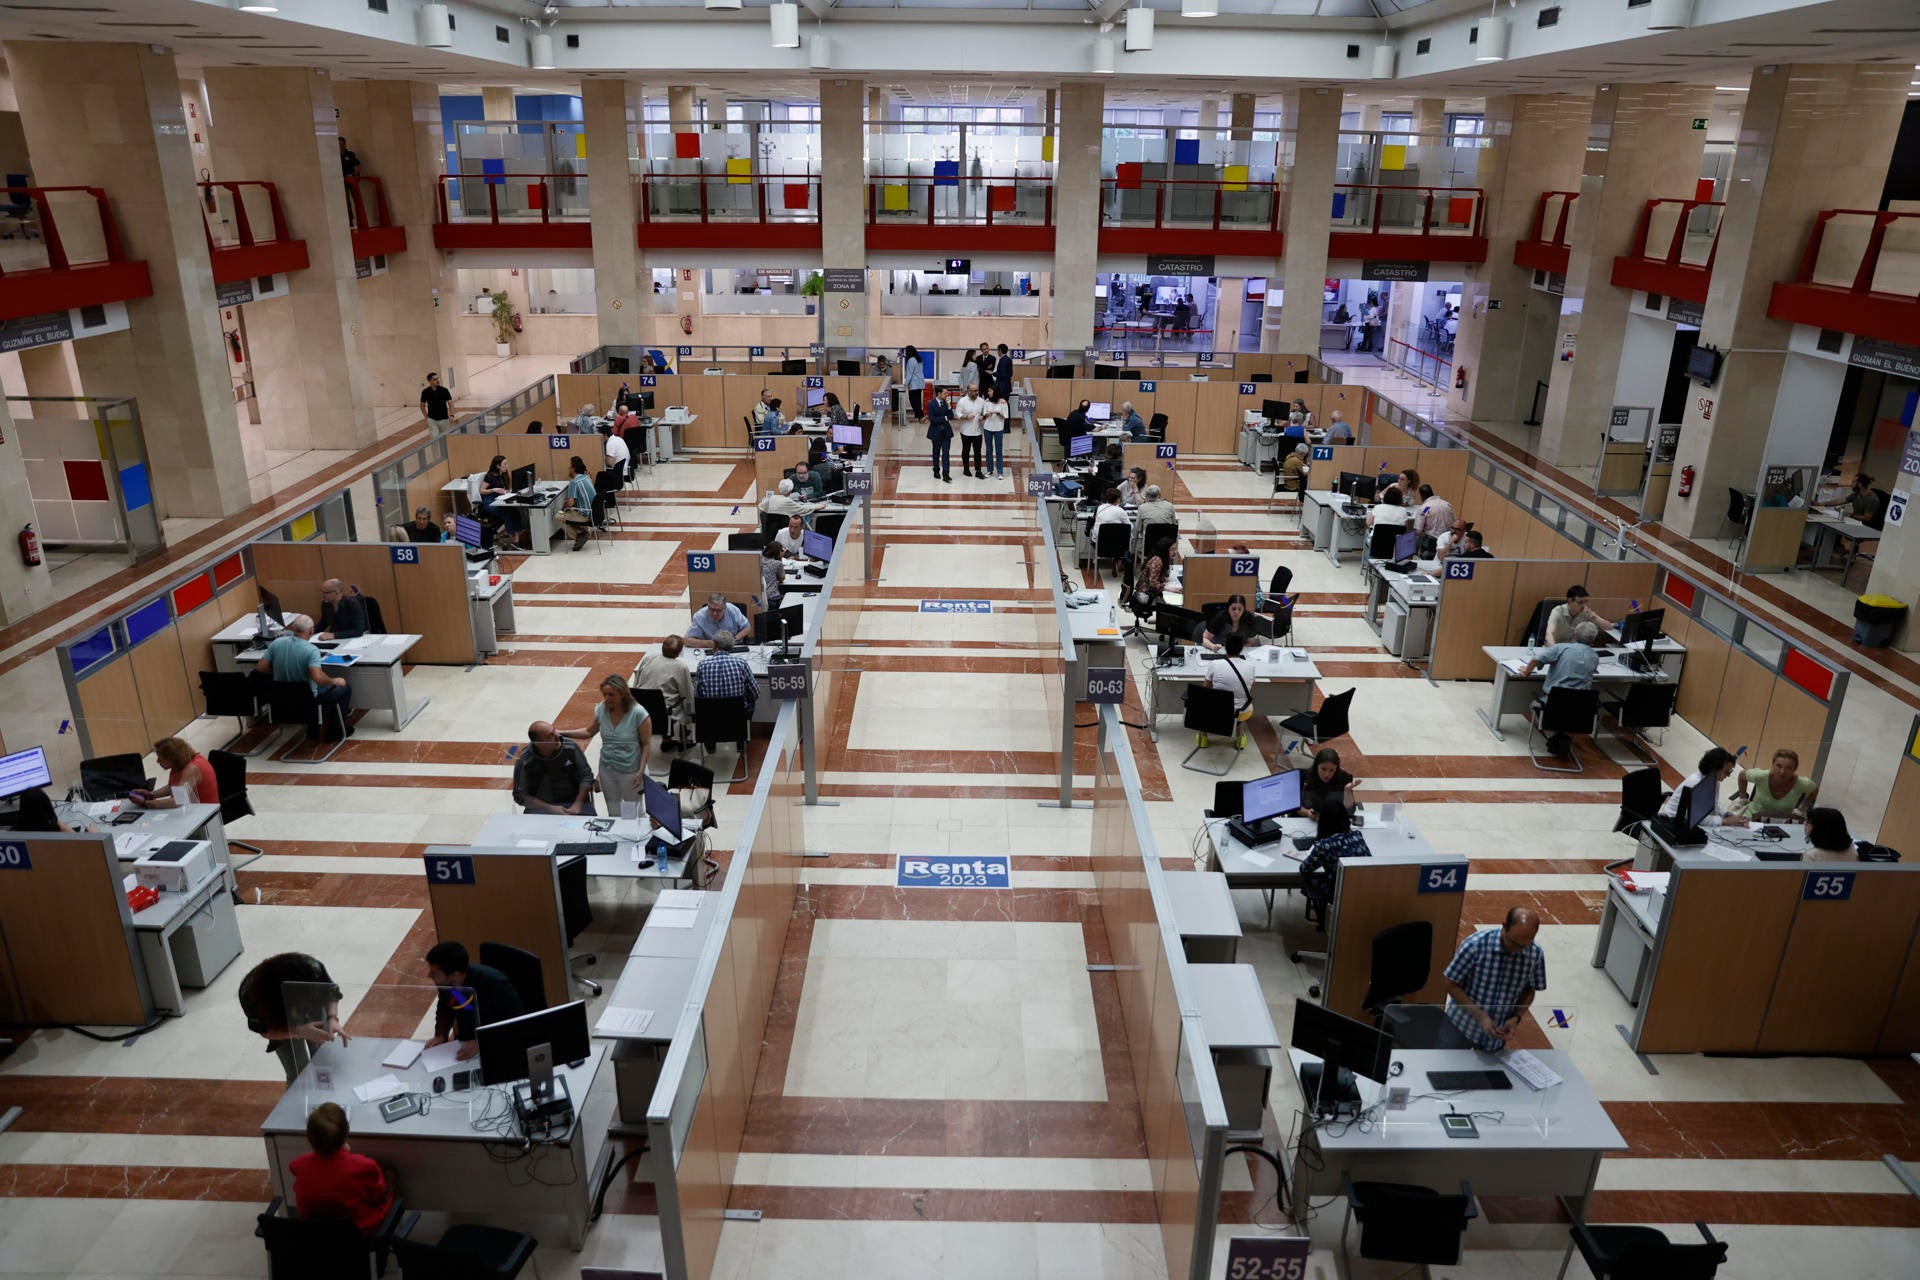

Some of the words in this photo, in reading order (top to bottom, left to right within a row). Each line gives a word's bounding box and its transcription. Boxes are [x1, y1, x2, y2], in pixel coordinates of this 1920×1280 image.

[1158, 263, 1203, 271] CATASTRO
[1373, 269, 1418, 277] CATASTRO
[35, 333, 44, 343] EL
[47, 329, 70, 341] BUENO
[1115, 351, 1125, 359] 84
[1200, 352, 1211, 360] 85
[1883, 360, 1892, 369] EL
[1895, 362, 1920, 374] BUENO
[642, 376, 654, 385] 74
[810, 378, 821, 387] 75
[1142, 382, 1153, 390] 78
[1242, 384, 1253, 393] 79
[873, 397, 890, 405] 72-75
[1614, 416, 1628, 424] 127
[553, 437, 567, 447] 66
[758, 440, 772, 450] 67
[1661, 436, 1676, 444] 126
[1160, 446, 1173, 456] 70
[1316, 449, 1329, 458] 71
[848, 480, 870, 489] 64-67
[1768, 475, 1784, 484] 125
[1029, 481, 1051, 491] 68-71
[397, 549, 414, 561] 58
[693, 556, 711, 569] 59
[1235, 561, 1254, 574] 62
[1450, 563, 1469, 577] 63
[771, 676, 805, 690] 56-59
[1089, 680, 1123, 694] 60-63
[437, 861, 463, 880] 51
[905, 861, 1006, 875] Renta
[940, 874, 987, 886] 2023
[1428, 869, 1457, 888] 54
[1814, 876, 1845, 895] 55
[1231, 1257, 1302, 1280] 52-55
